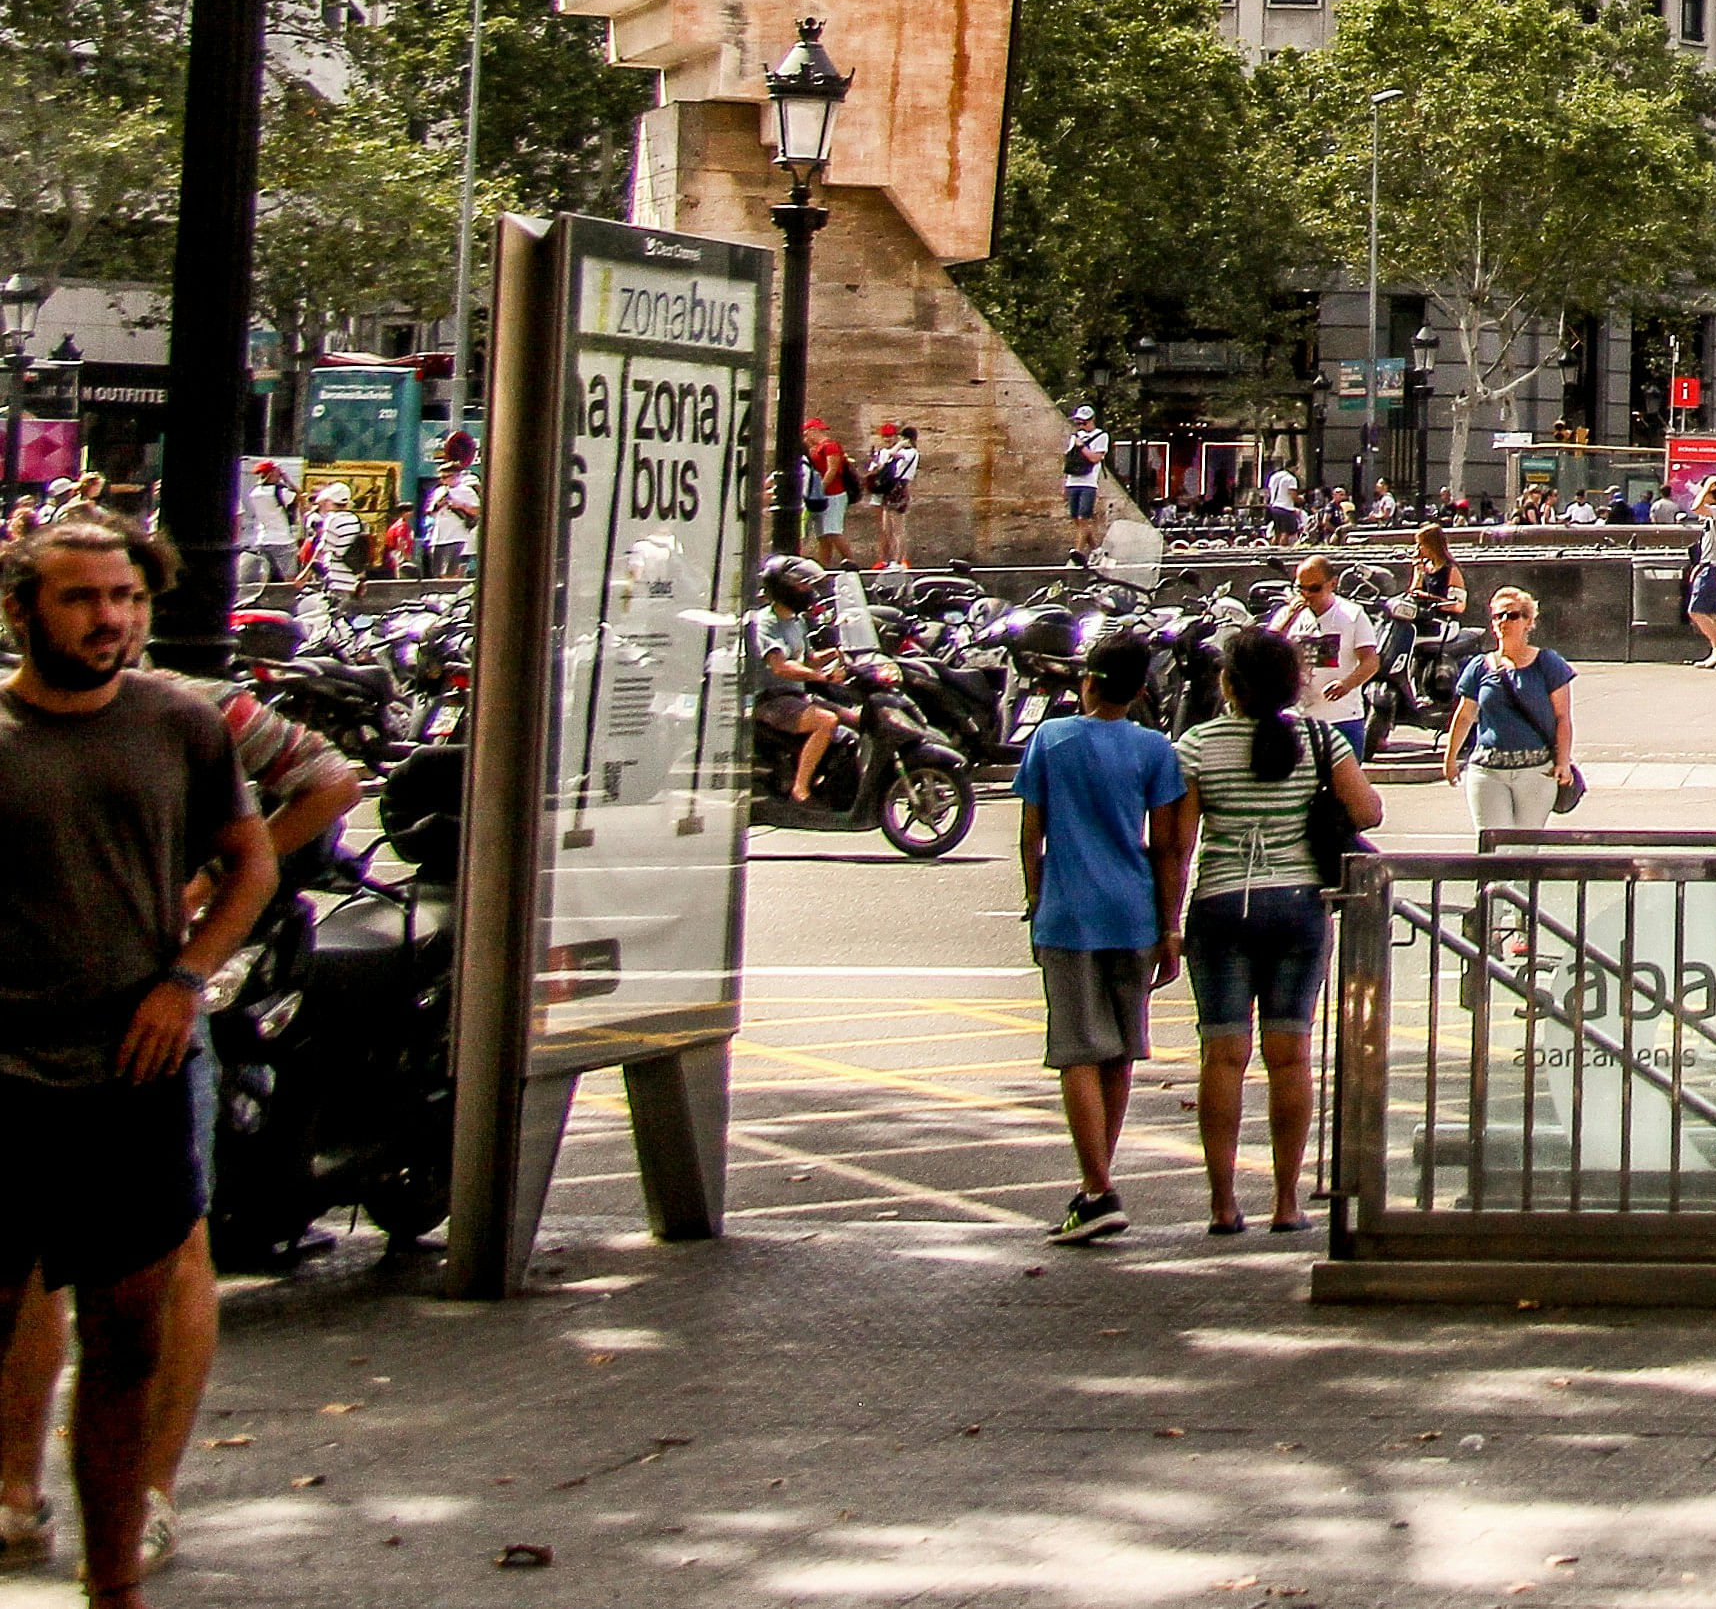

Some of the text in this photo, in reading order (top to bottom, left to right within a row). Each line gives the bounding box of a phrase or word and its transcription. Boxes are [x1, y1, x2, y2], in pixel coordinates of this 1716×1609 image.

[617, 280, 741, 348] zonabus
[631, 378, 721, 446] zona
[631, 443, 700, 522] bus
